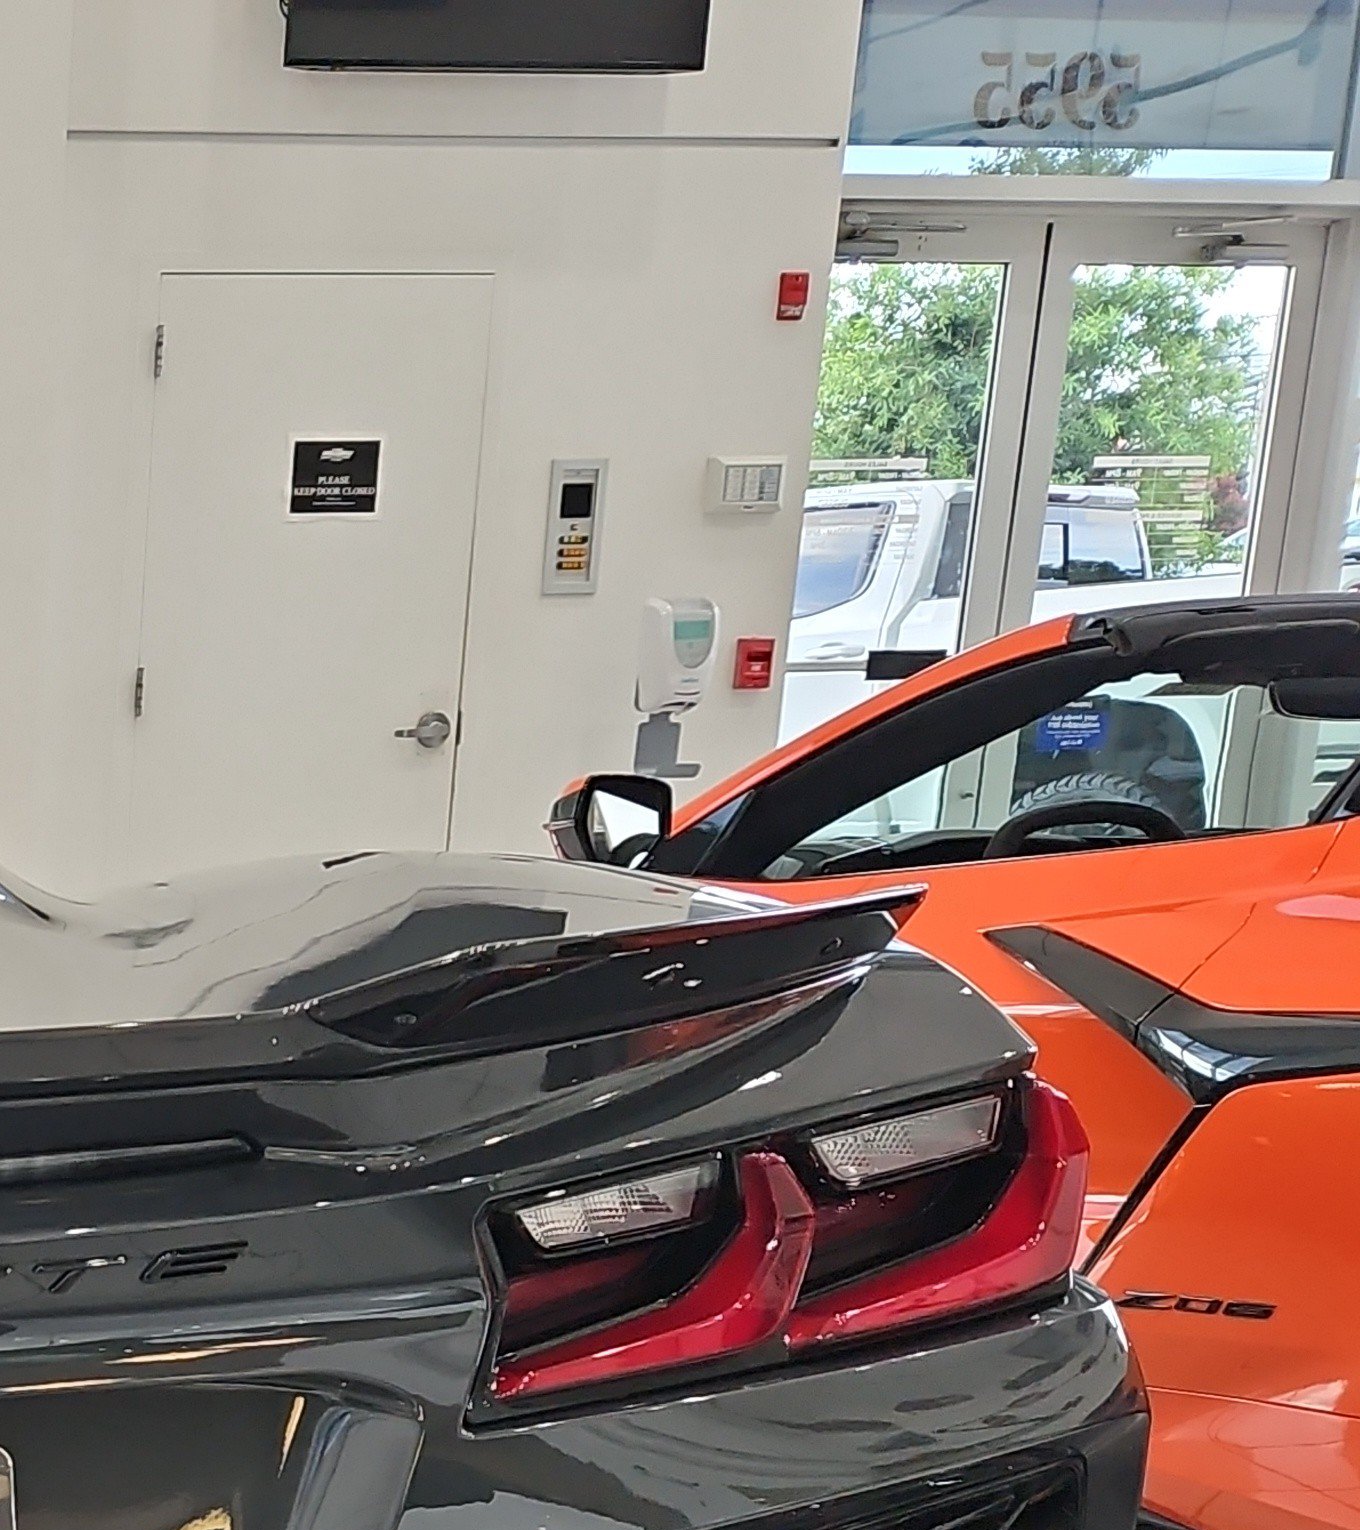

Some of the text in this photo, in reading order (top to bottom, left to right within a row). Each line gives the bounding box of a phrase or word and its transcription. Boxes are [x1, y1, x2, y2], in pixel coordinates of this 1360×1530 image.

[317, 476, 350, 485] PLEASE
[294, 486, 376, 496] KEEP DOOR CLOSED
[1114, 1289, 1277, 1319] Z06
